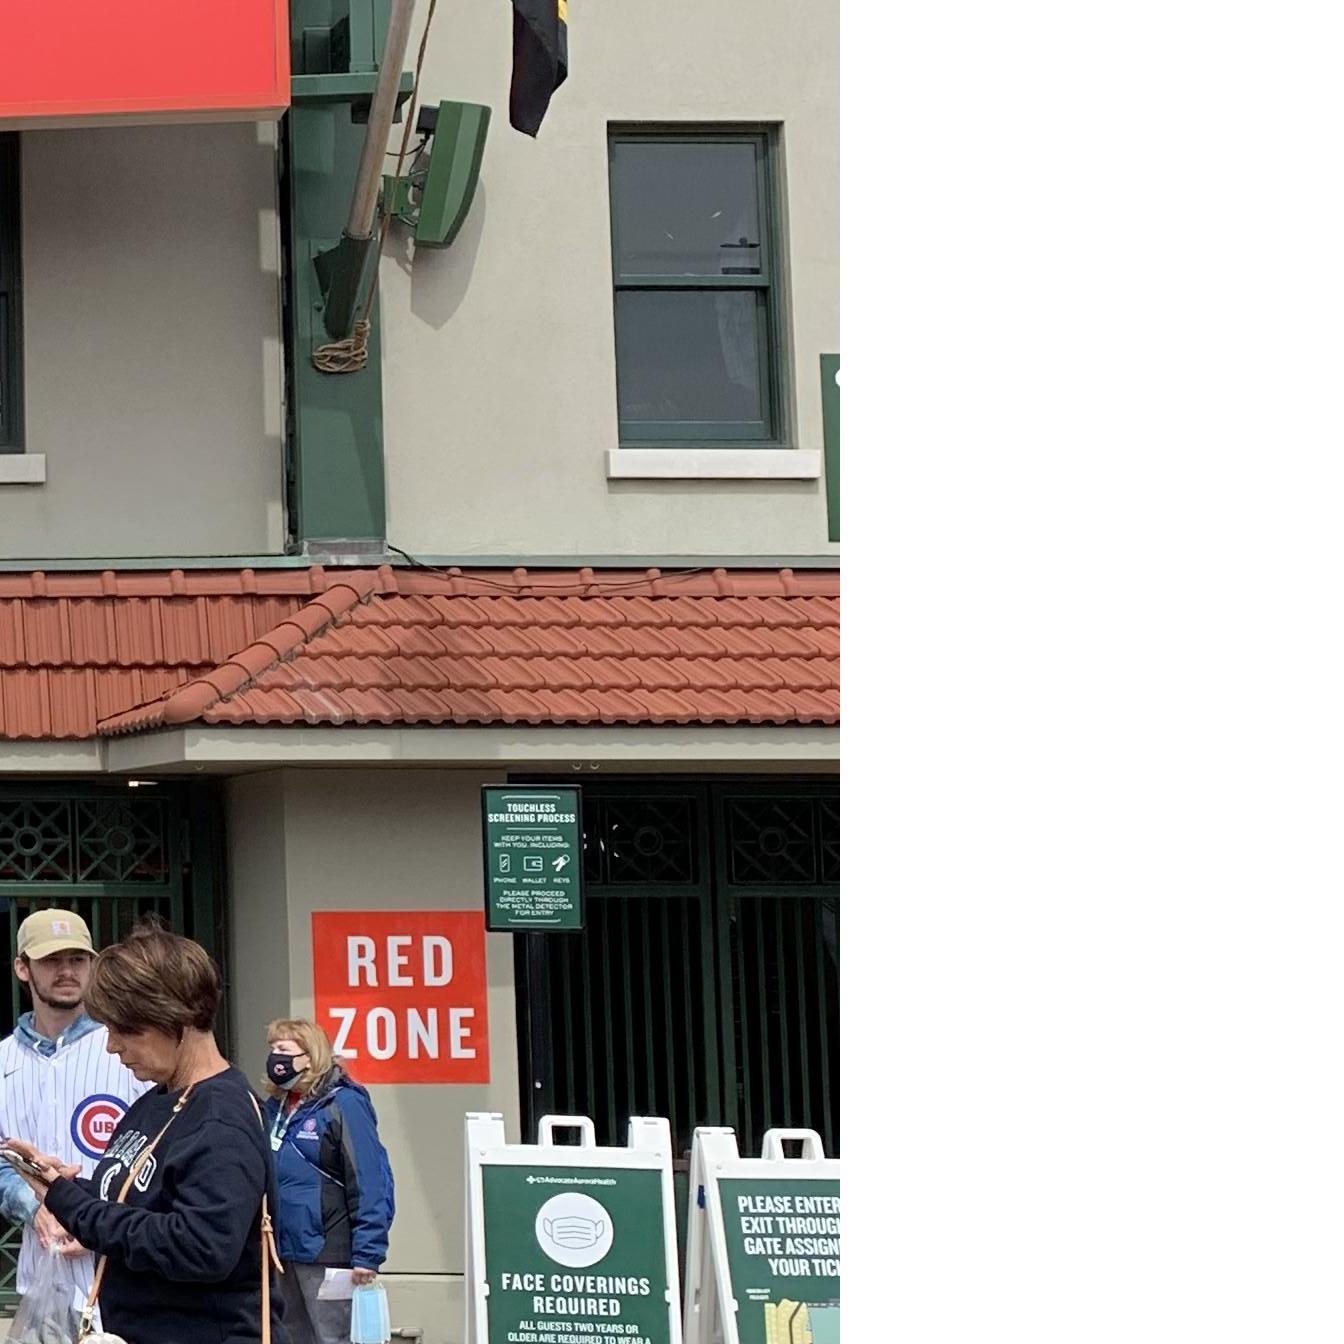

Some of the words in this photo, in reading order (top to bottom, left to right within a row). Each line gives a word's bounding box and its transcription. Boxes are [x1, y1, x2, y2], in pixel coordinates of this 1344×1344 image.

[507, 804, 556, 813] TOUCHLESS
[488, 813, 535, 823] SCREENING
[537, 814, 576, 823] PROCESS
[347, 936, 453, 987] RED
[329, 1007, 476, 1060] ZONE
[738, 1196, 793, 1213] PLEASE
[795, 1196, 840, 1213] ENTER
[741, 1217, 773, 1234] EXIT
[744, 1237, 783, 1255] GATE
[785, 1237, 840, 1255] ASSIGN
[768, 1258, 811, 1276] YOUR
[501, 1273, 545, 1291] FACE
[551, 1274, 650, 1295] COVERINGS
[533, 1296, 621, 1316] REQUIRED
[519, 1320, 536, 1331] ALL
[537, 1321, 572, 1331] GUESTS
[573, 1322, 593, 1332] TWO
[595, 1323, 624, 1333] YEARS
[625, 1324, 638, 1334] OR
[508, 1332, 537, 1342] OLDER
[539, 1334, 556, 1343] ARE
[558, 1334, 602, 1344] REQUIRED
[604, 1336, 616, 1344] TO
